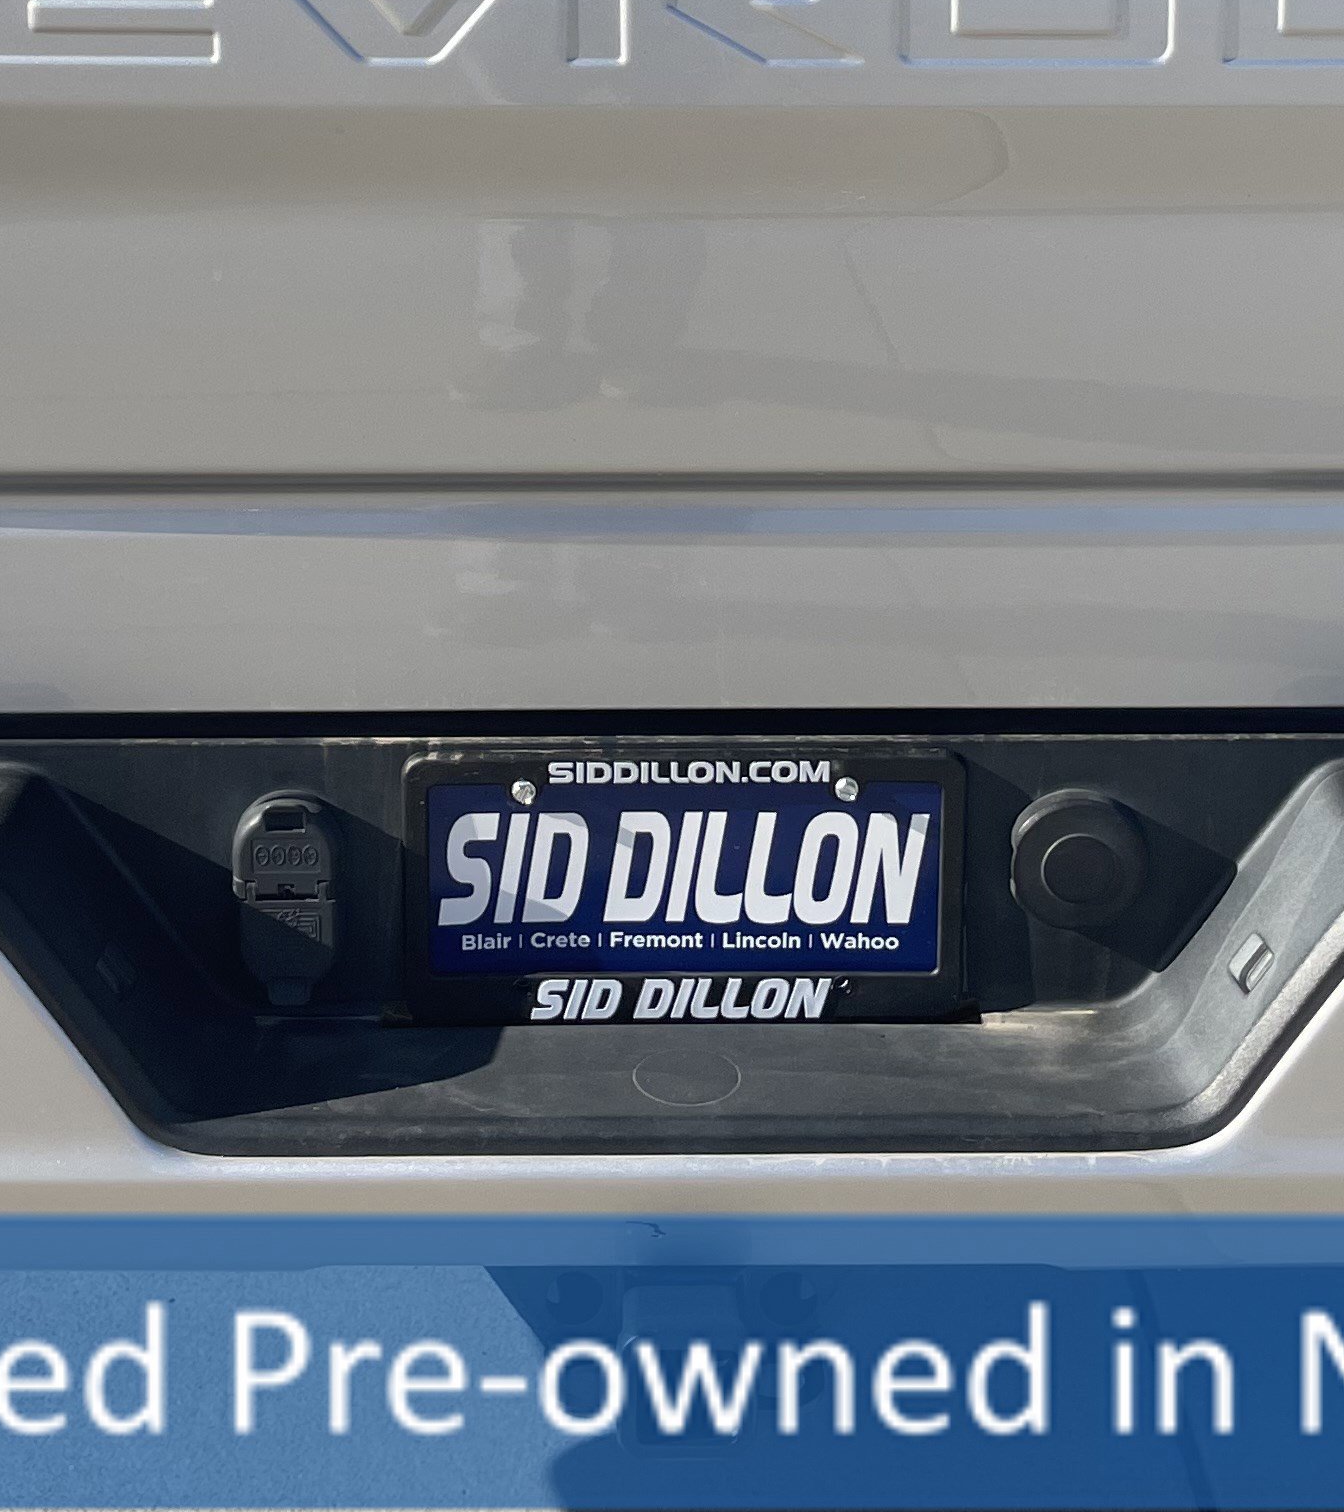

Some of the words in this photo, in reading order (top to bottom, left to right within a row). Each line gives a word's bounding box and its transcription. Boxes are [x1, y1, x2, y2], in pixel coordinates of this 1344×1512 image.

[547, 759, 831, 785] SIDDILLON.COM
[437, 811, 590, 926] SID
[602, 811, 931, 926] DILLON
[460, 933, 512, 951] Blair
[529, 931, 591, 949] Crete
[608, 931, 704, 949] Fremont
[721, 931, 802, 949] Lincoln
[819, 931, 900, 951] Wahoo
[529, 978, 623, 1021] SID
[631, 977, 833, 1021] DILLON
